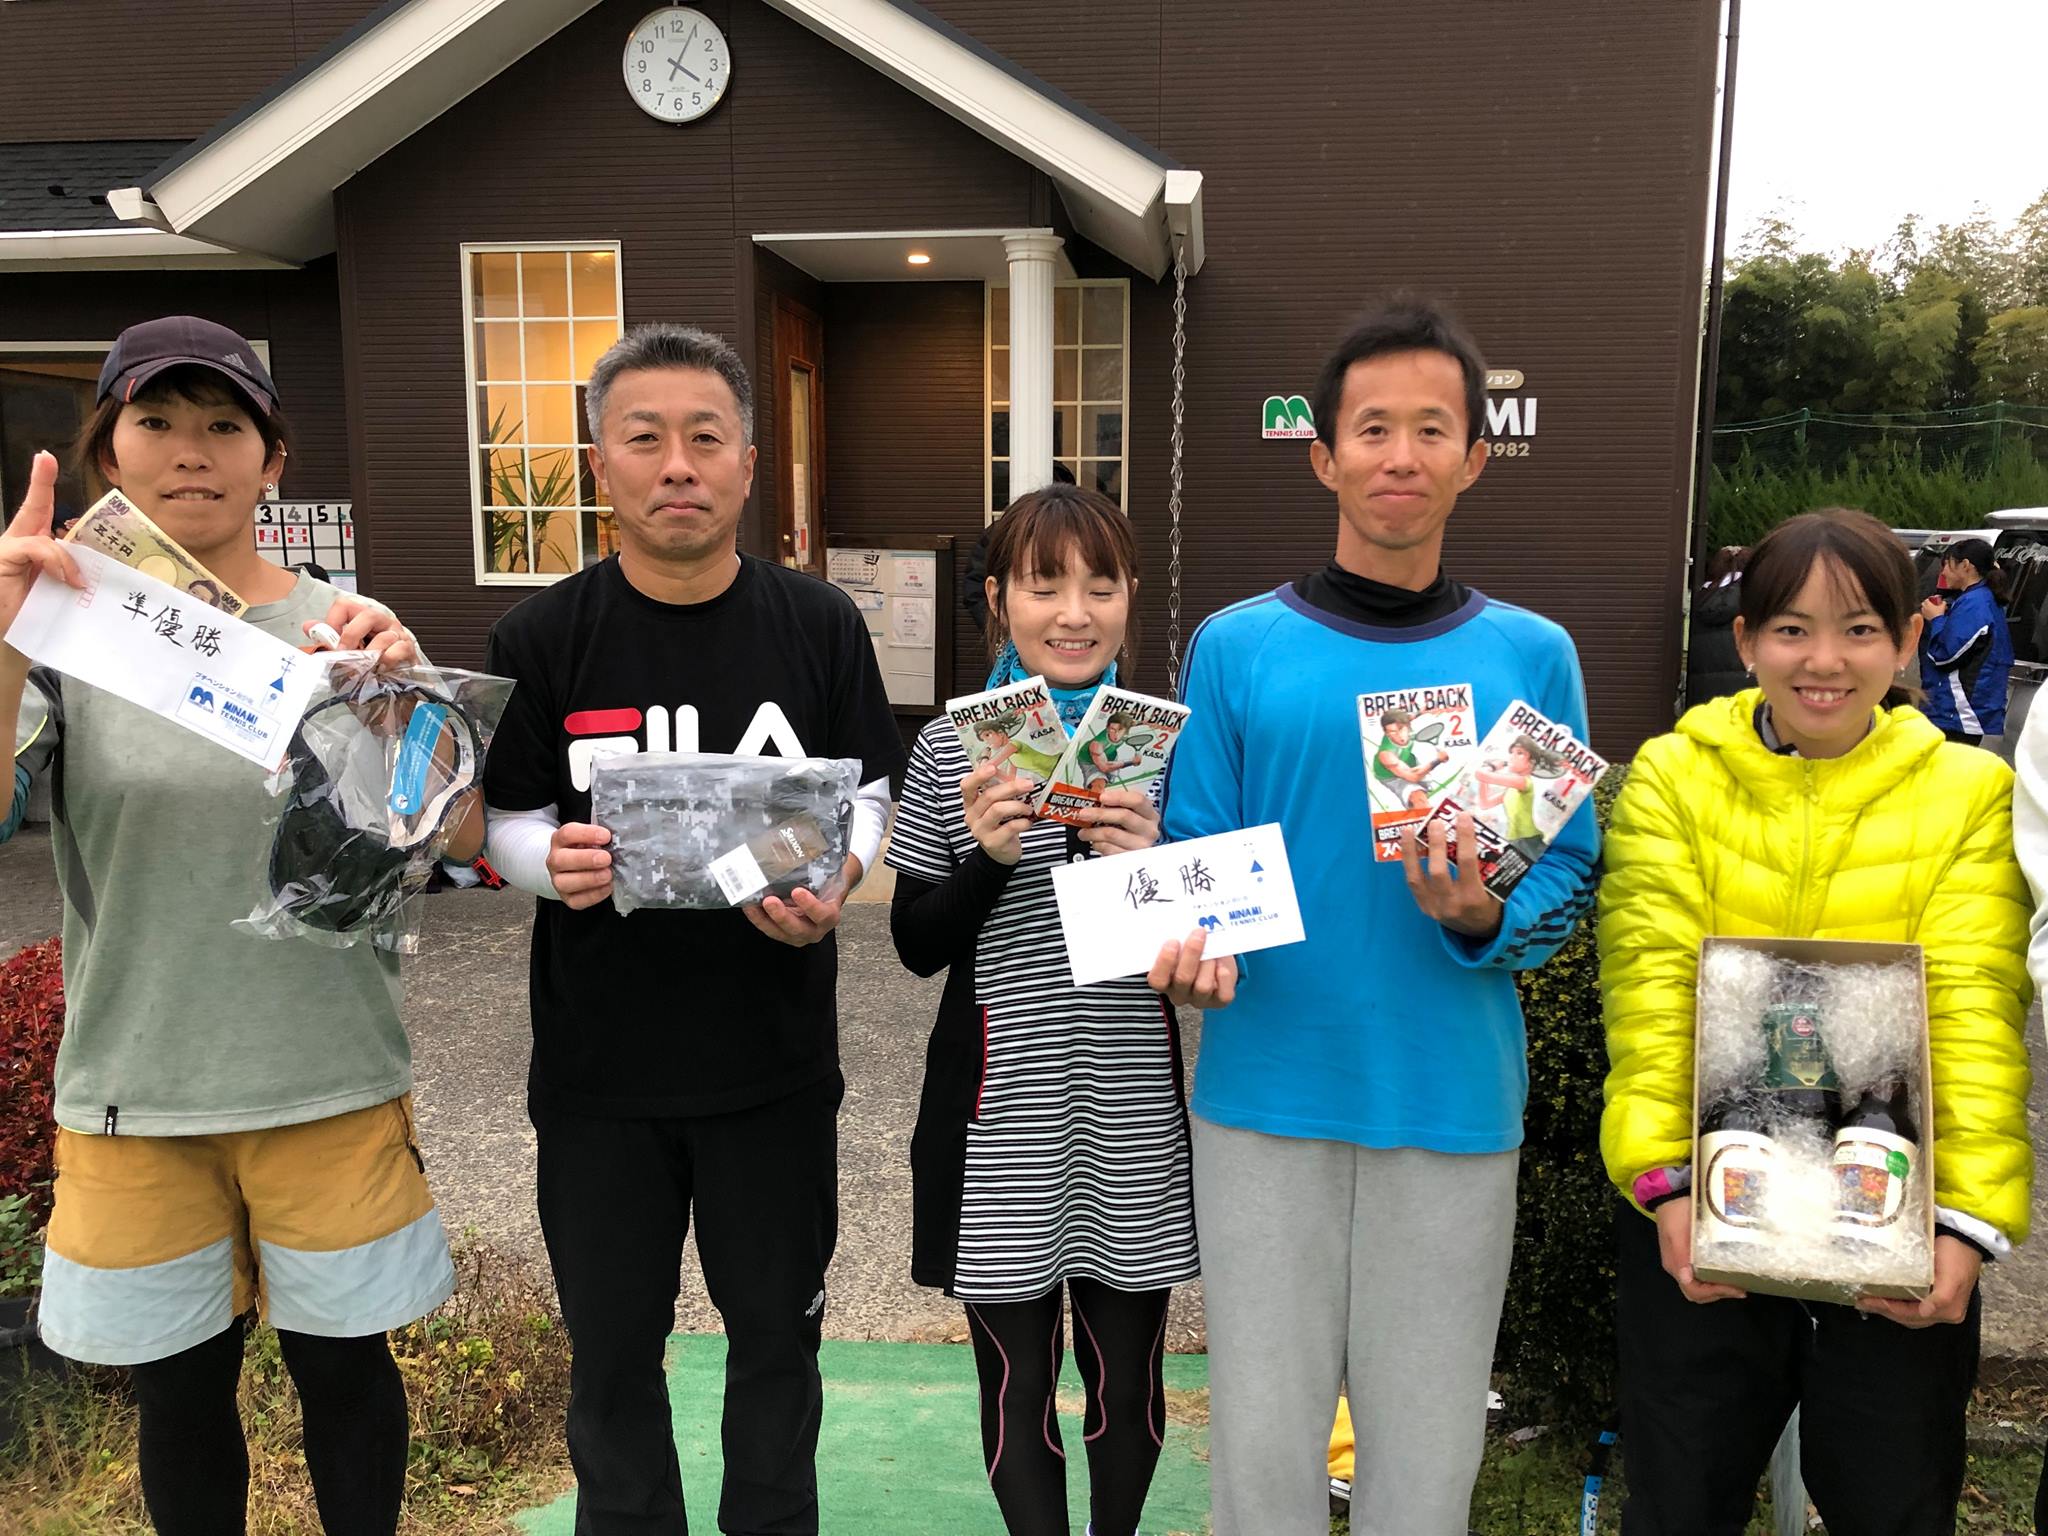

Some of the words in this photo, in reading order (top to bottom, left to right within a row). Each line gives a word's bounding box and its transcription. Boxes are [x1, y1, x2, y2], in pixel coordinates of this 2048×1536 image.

[654, 26, 665, 39] 11
[670, 20, 684, 33] 12
[640, 40, 655, 54] 10
[704, 39, 714, 52] 2
[638, 60, 647, 73] 9
[709, 58, 719, 72] 3
[642, 79, 652, 92] 8
[704, 78, 714, 91] 4
[656, 93, 665, 106] 7
[673, 98, 683, 111] 6
[692, 92, 701, 105] 5
[1484, 442, 1530, 457] 1982
[108, 495, 130, 516] 5000
[259, 505, 273, 523] 3
[287, 506, 301, 522] 4
[317, 505, 329, 523] 5
[93, 523, 134, 557] 五千円
[221, 591, 242, 612] 5000
[122, 592, 223, 657] 準優勝
[951, 700, 1001, 728] BREAK
[1003, 684, 1048, 711] BACK
[1363, 691, 1420, 717] BREAK
[1424, 687, 1469, 711] BACK
[223, 701, 258, 725] MINAMI
[1032, 711, 1044, 727] 1
[1100, 695, 1152, 721] BREAK
[1148, 706, 1188, 729] BACK
[220, 710, 247, 727] TENNIS
[248, 725, 268, 738] CLUB
[1449, 715, 1463, 736] 2
[1029, 726, 1056, 740] KASA
[1153, 733, 1169, 749] 2
[1444, 738, 1472, 747] KASA
[1509, 706, 1565, 751] BREAK
[1563, 741, 1604, 781] BACK
[1142, 749, 1164, 760] KASA
[1561, 779, 1577, 797] 1
[1050, 794, 1076, 806] BREAK
[1543, 790, 1567, 812] KASA
[1124, 856, 1215, 910] 優勝
[1229, 906, 1262, 920] MINAMI
